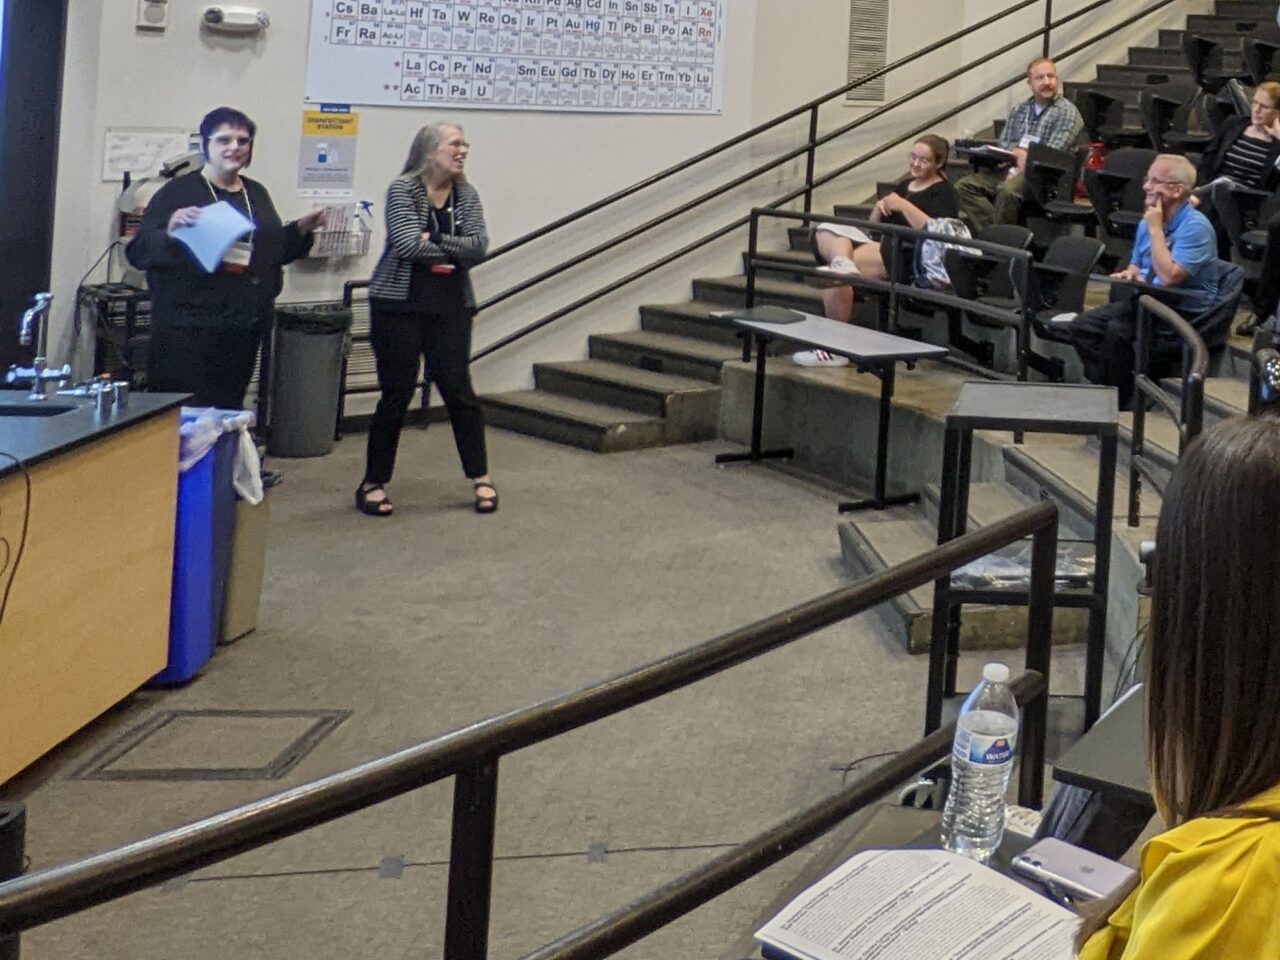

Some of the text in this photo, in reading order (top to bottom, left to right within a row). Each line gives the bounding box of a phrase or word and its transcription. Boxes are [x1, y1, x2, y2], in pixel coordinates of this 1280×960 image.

[609, 1, 618, 10] In
[625, 1, 638, 11] Sn
[644, 3, 657, 12] Sb
[664, 5, 675, 14] Te
[701, 8, 712, 16] Xe
[336, 2, 353, 13] Cs
[360, 4, 378, 15] Ba
[410, 8, 423, 18] Hf
[432, 9, 446, 20] Ta
[458, 11, 470, 21] W
[479, 12, 495, 24] Re
[501, 14, 517, 25] Os
[527, 16, 535, 26] Ir
[546, 18, 558, 27] Pt
[565, 19, 580, 29] Au
[585, 20, 600, 31] Hg
[608, 22, 616, 31] Tl
[624, 23, 637, 32] Pb
[644, 24, 654, 34] Bi
[662, 26, 675, 35] Po
[681, 27, 692, 36] At
[699, 27, 711, 37] Rn
[336, 26, 350, 38] Fr
[359, 28, 376, 39] Ra
[406, 60, 421, 71] La
[428, 60, 445, 71] Ce
[454, 62, 468, 72] Pr
[475, 63, 492, 74] Nd
[518, 66, 536, 76] Sm
[541, 67, 556, 76] Eu
[561, 67, 577, 77] Gd
[583, 68, 596, 78] Tb
[602, 70, 616, 81] Dy
[621, 70, 635, 80] Ho
[642, 71, 653, 81] Er
[658, 72, 674, 81] Tm
[678, 73, 691, 82] Yb
[697, 73, 709, 83] Lu
[404, 83, 420, 94] Ac
[428, 84, 443, 95] Th
[451, 85, 466, 96] Pa
[477, 86, 486, 96] U
